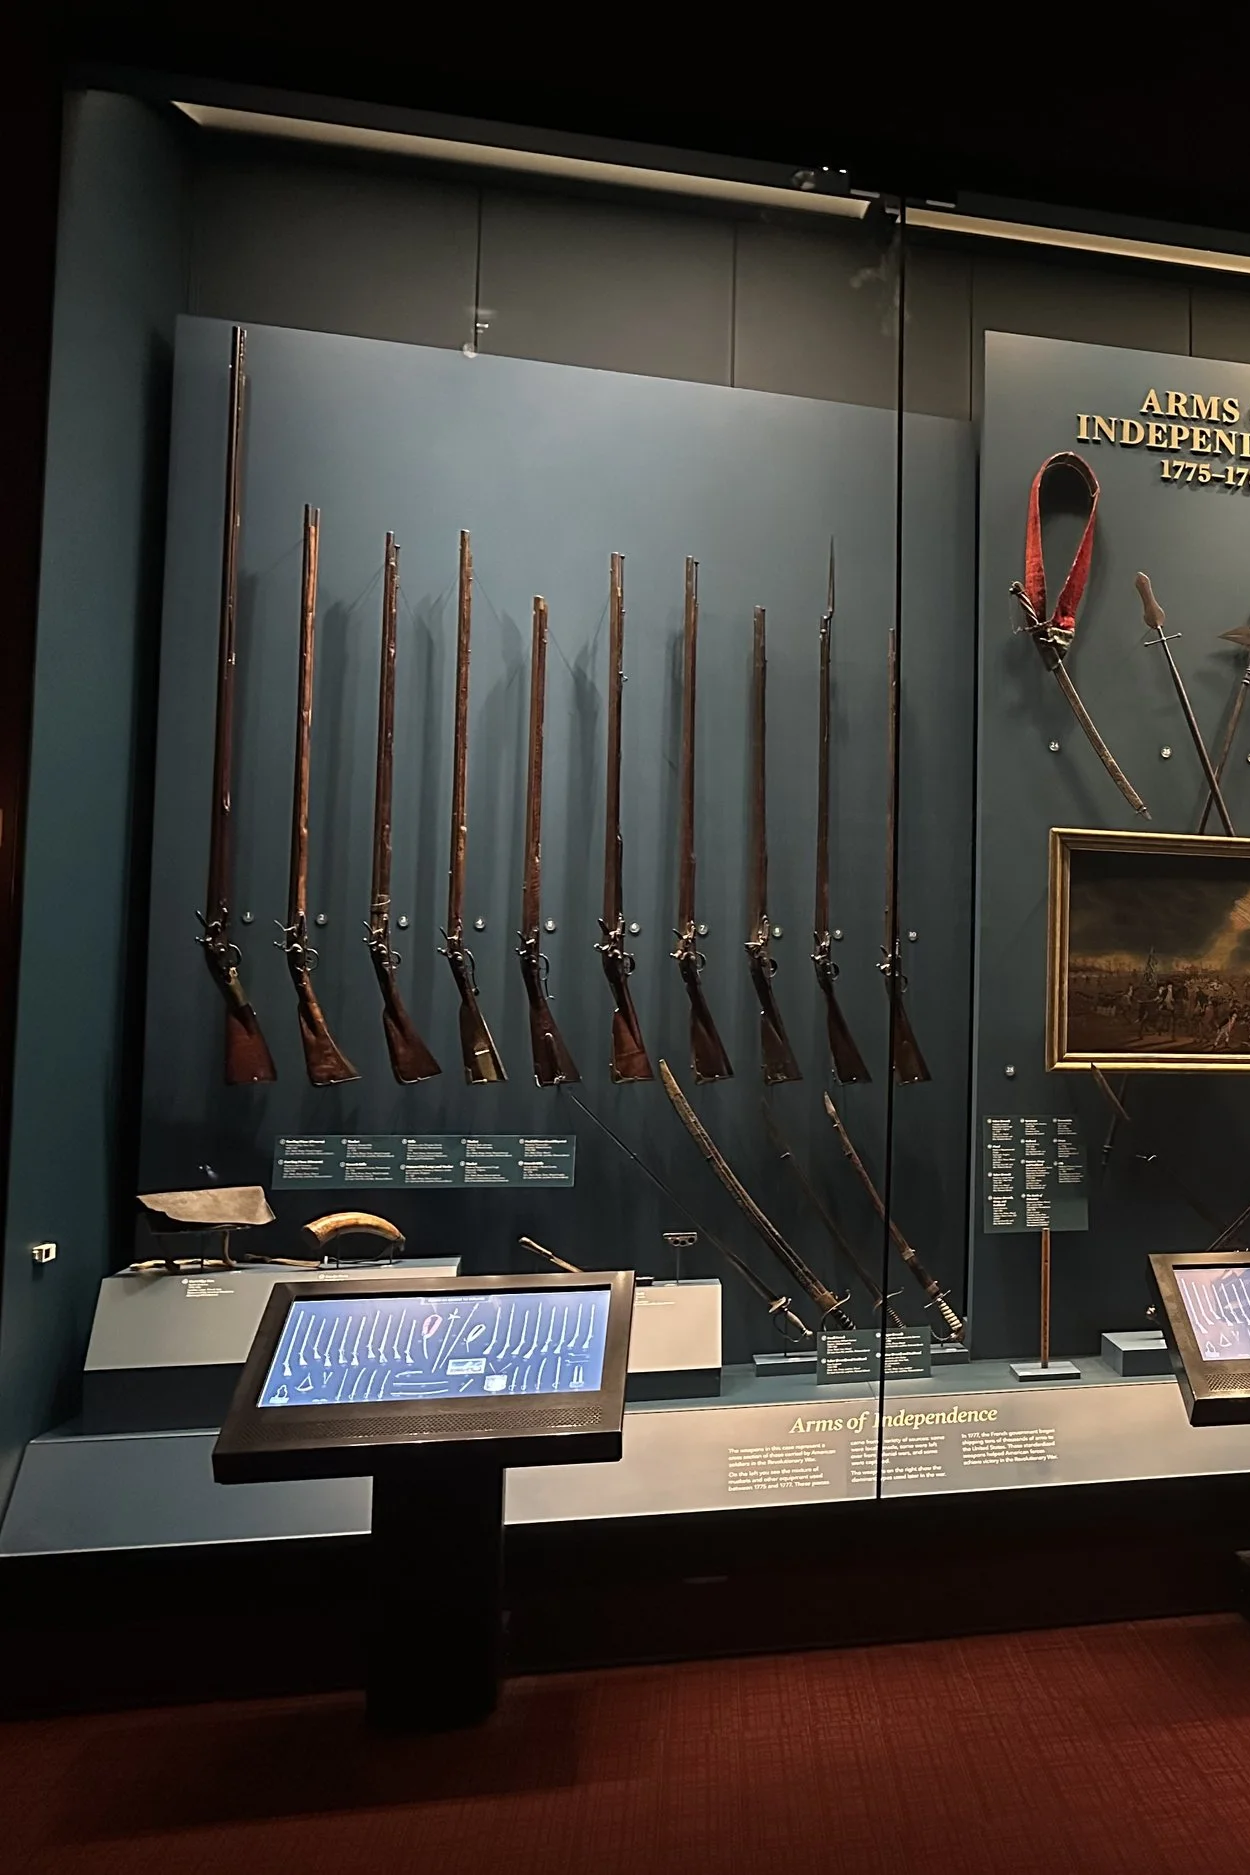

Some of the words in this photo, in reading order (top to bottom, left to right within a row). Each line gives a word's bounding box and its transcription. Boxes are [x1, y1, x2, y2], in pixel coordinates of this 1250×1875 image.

[1139, 388, 1240, 424] ARMS
[789, 1417, 844, 1434] Arms
[846, 1411, 870, 1434] of
